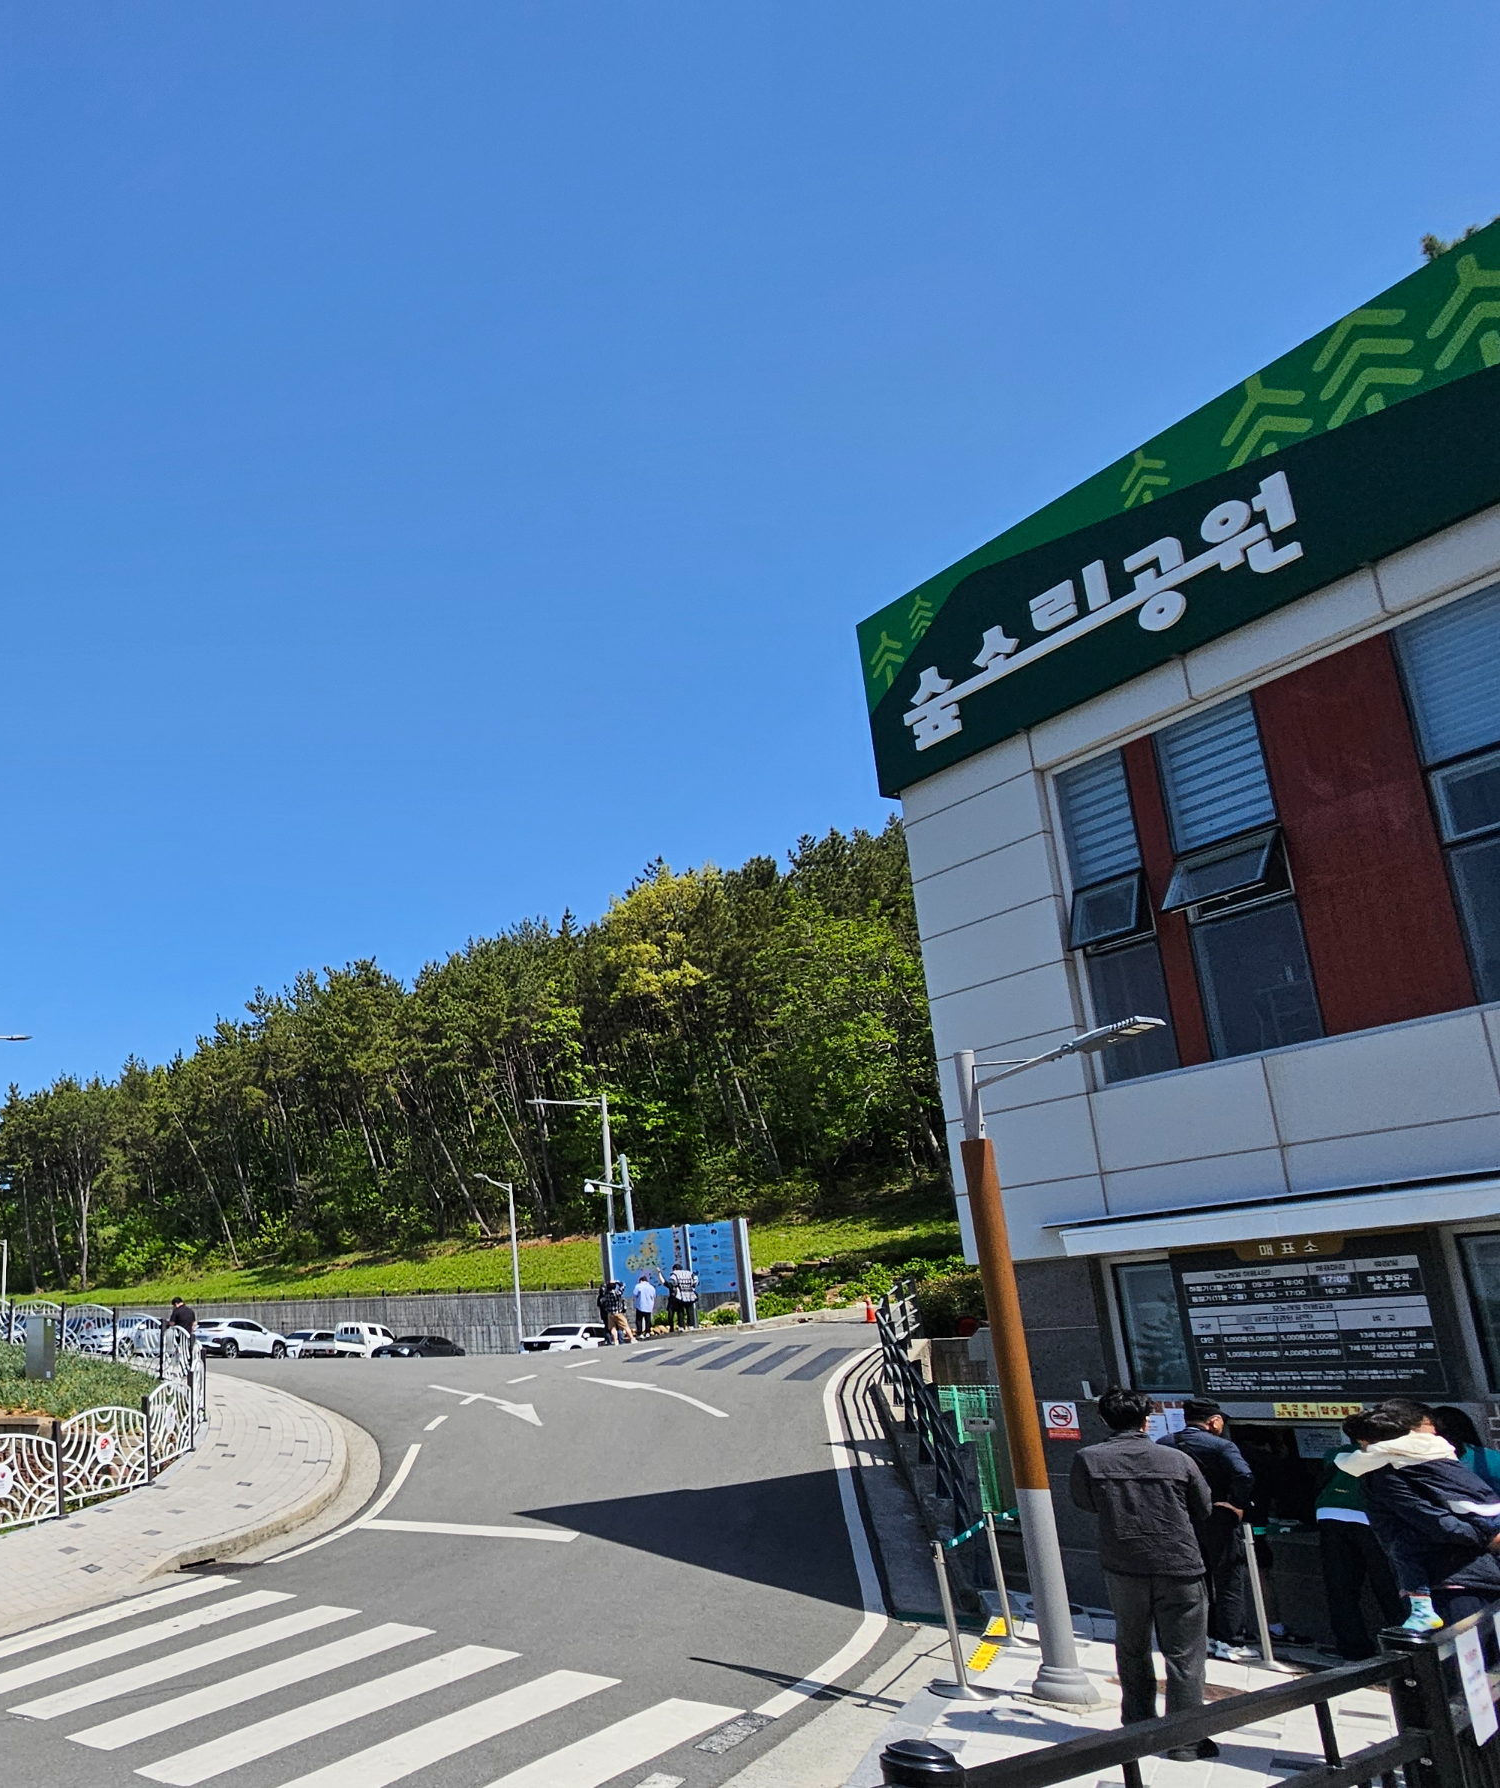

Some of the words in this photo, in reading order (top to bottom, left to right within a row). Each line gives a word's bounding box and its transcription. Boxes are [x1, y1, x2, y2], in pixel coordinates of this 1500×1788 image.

[903, 470, 1303, 752] 숲소리공원
[1258, 1240, 1319, 1256] 매표소
[1321, 1275, 1350, 1284] 17:00
[1284, 1289, 1306, 1297] 17:00
[1324, 1287, 1347, 1295] 16:30
